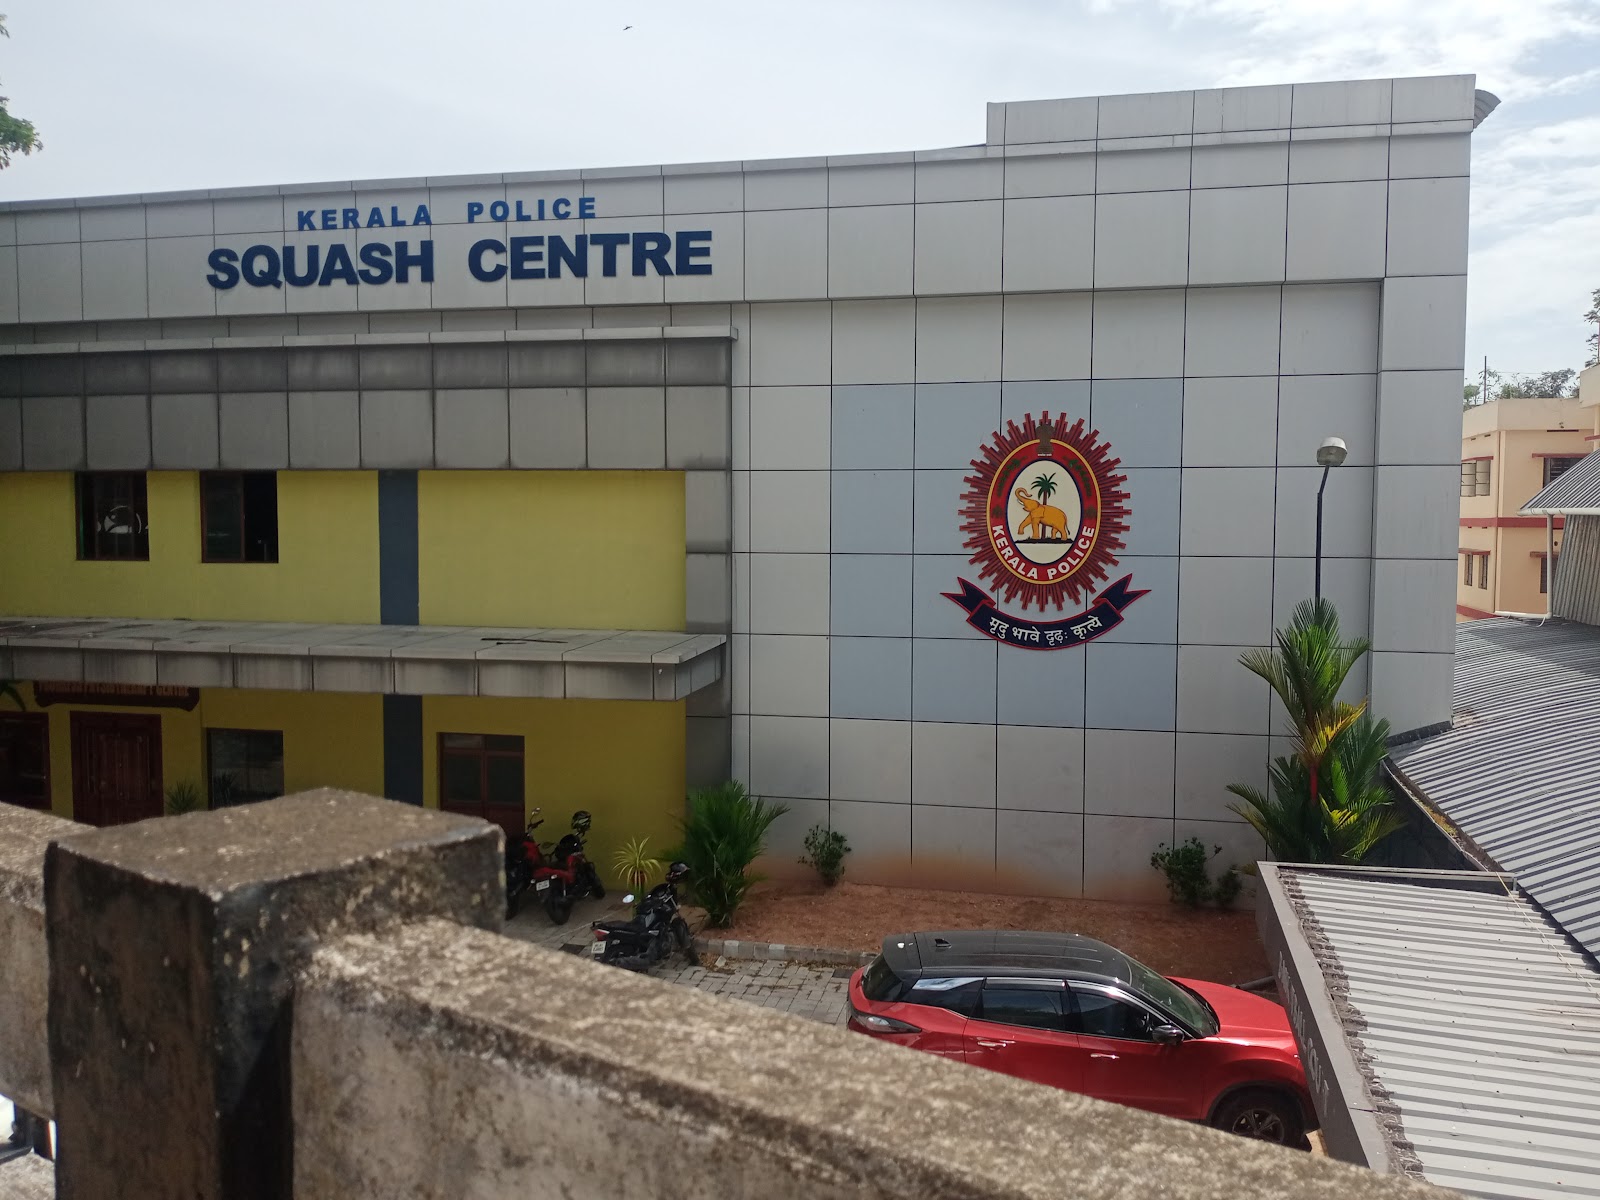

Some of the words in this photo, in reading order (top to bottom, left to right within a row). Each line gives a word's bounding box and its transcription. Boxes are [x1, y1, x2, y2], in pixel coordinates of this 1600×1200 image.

[297, 204, 433, 232] KERALA
[466, 196, 597, 224] POLICE
[206, 239, 435, 291] SQUASH
[467, 229, 714, 283] CENTRE
[992, 525, 1038, 580] KERALA
[1046, 525, 1095, 580] POLICE
[989, 616, 1010, 640] मृदु
[1011, 626, 1041, 643] भावे
